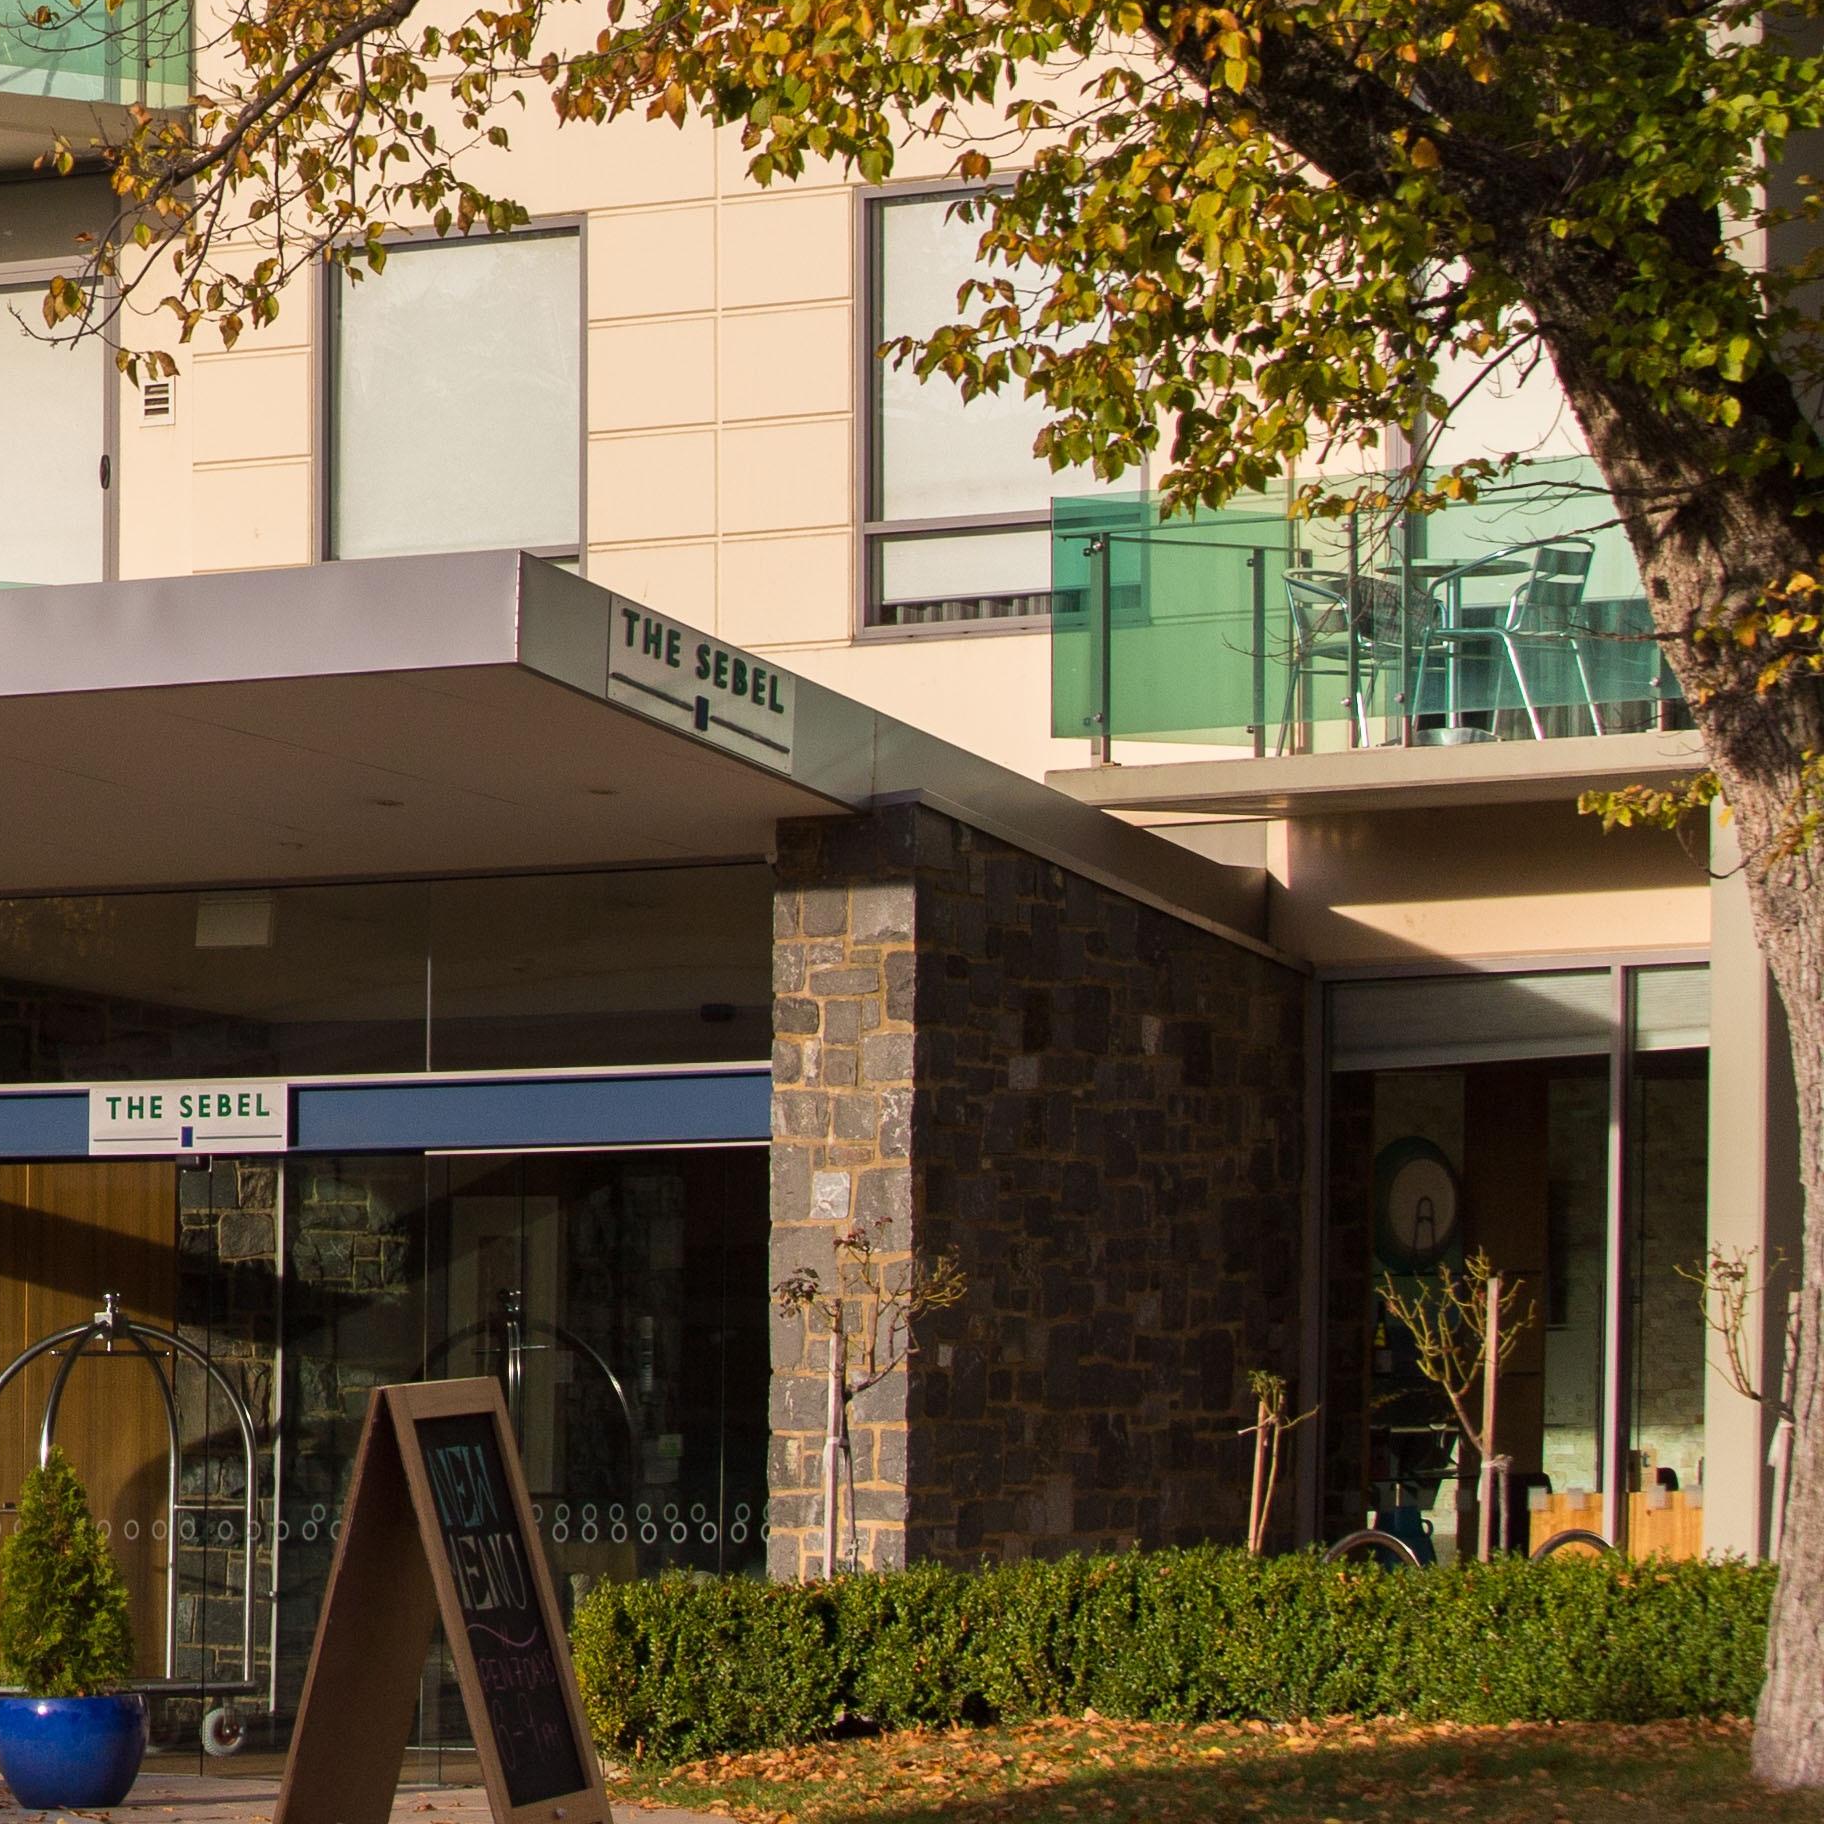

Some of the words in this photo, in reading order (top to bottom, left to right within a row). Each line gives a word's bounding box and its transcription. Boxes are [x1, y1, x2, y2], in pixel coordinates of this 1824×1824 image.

[621, 607, 682, 669] THE
[695, 642, 785, 715] SEBEL
[105, 1095, 164, 1120] THE
[179, 1092, 271, 1119] SEBEL
[427, 1444, 499, 1528] NEW
